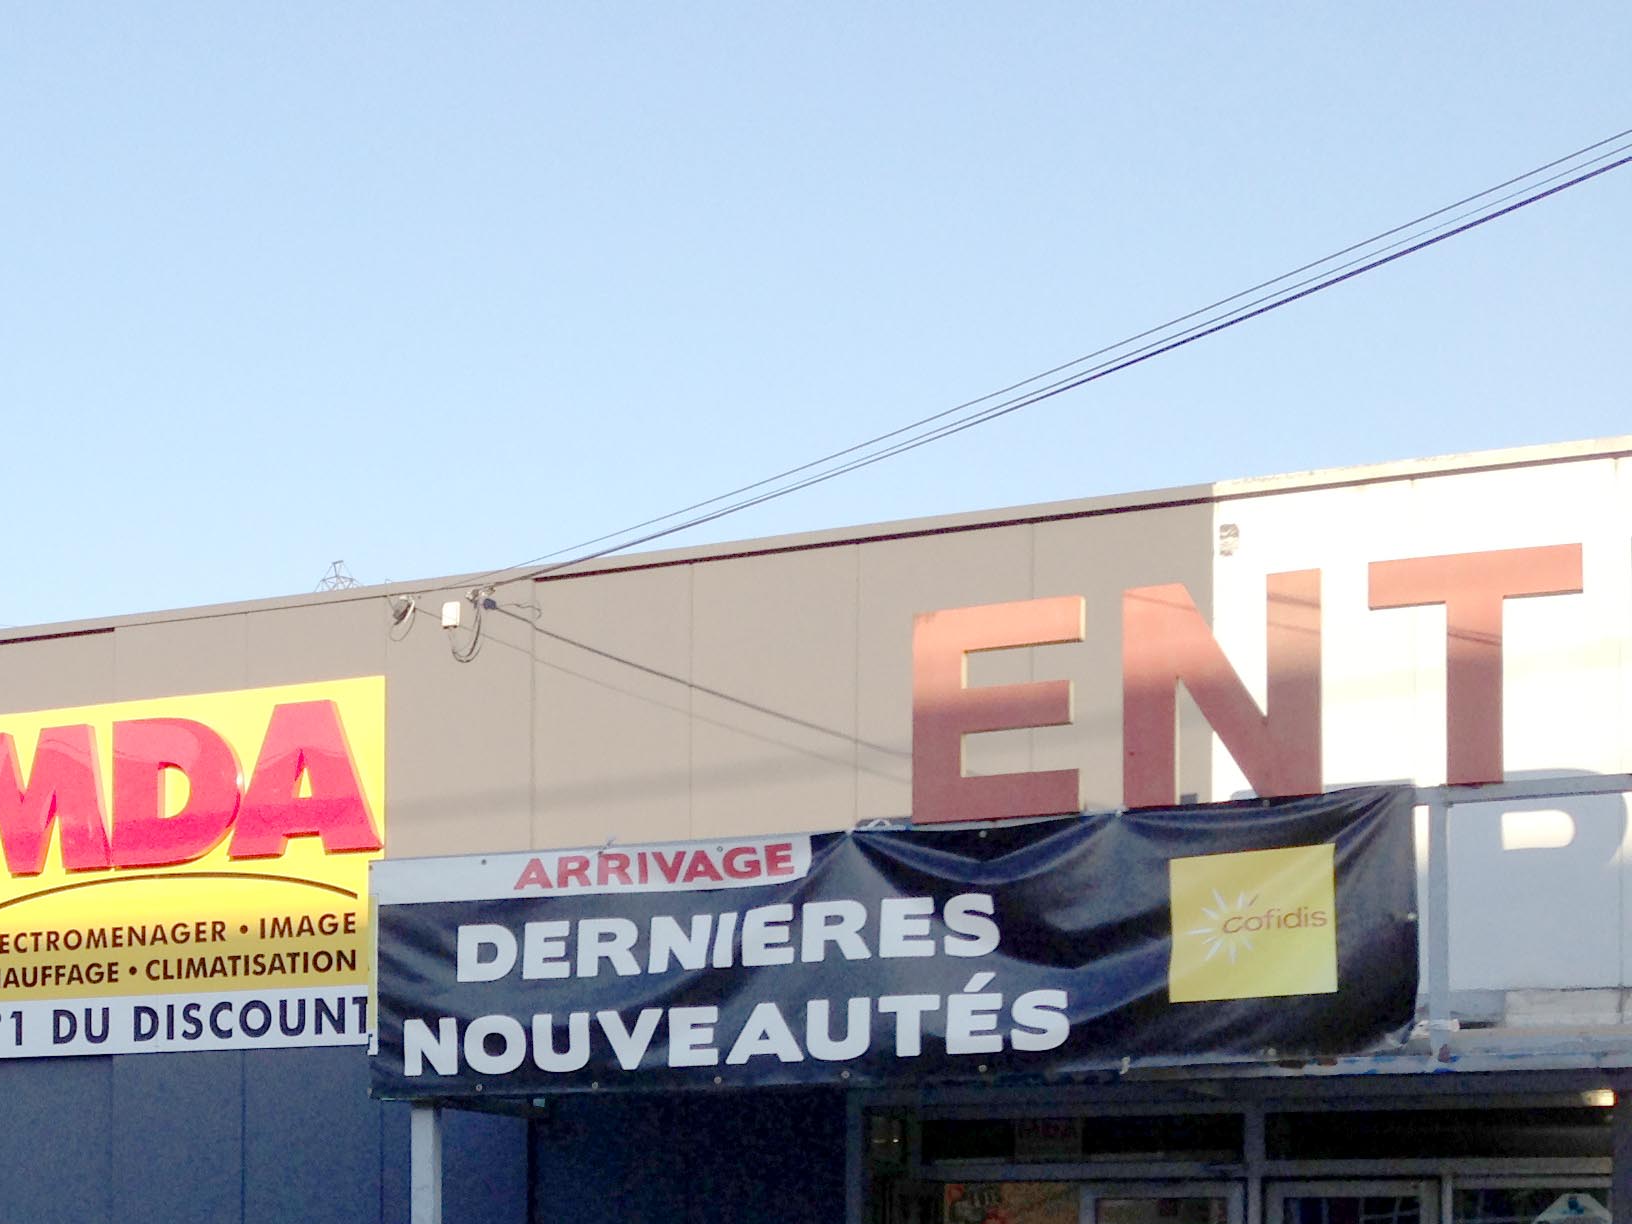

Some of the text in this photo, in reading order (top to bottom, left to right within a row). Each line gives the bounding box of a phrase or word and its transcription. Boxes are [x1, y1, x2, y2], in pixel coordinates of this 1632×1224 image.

[913, 543, 1632, 825] ENT
[513, 843, 795, 890] ARRIVAGE
[260, 912, 356, 939] IMAGE
[456, 893, 1001, 983] DERNIERES
[1222, 906, 1328, 934] cofidis
[146, 949, 356, 981] CLIMATISATION
[53, 1007, 109, 1045] DU
[134, 996, 368, 1042] DISCOUNT
[403, 972, 1070, 1077] NOUVEAUTÉS
